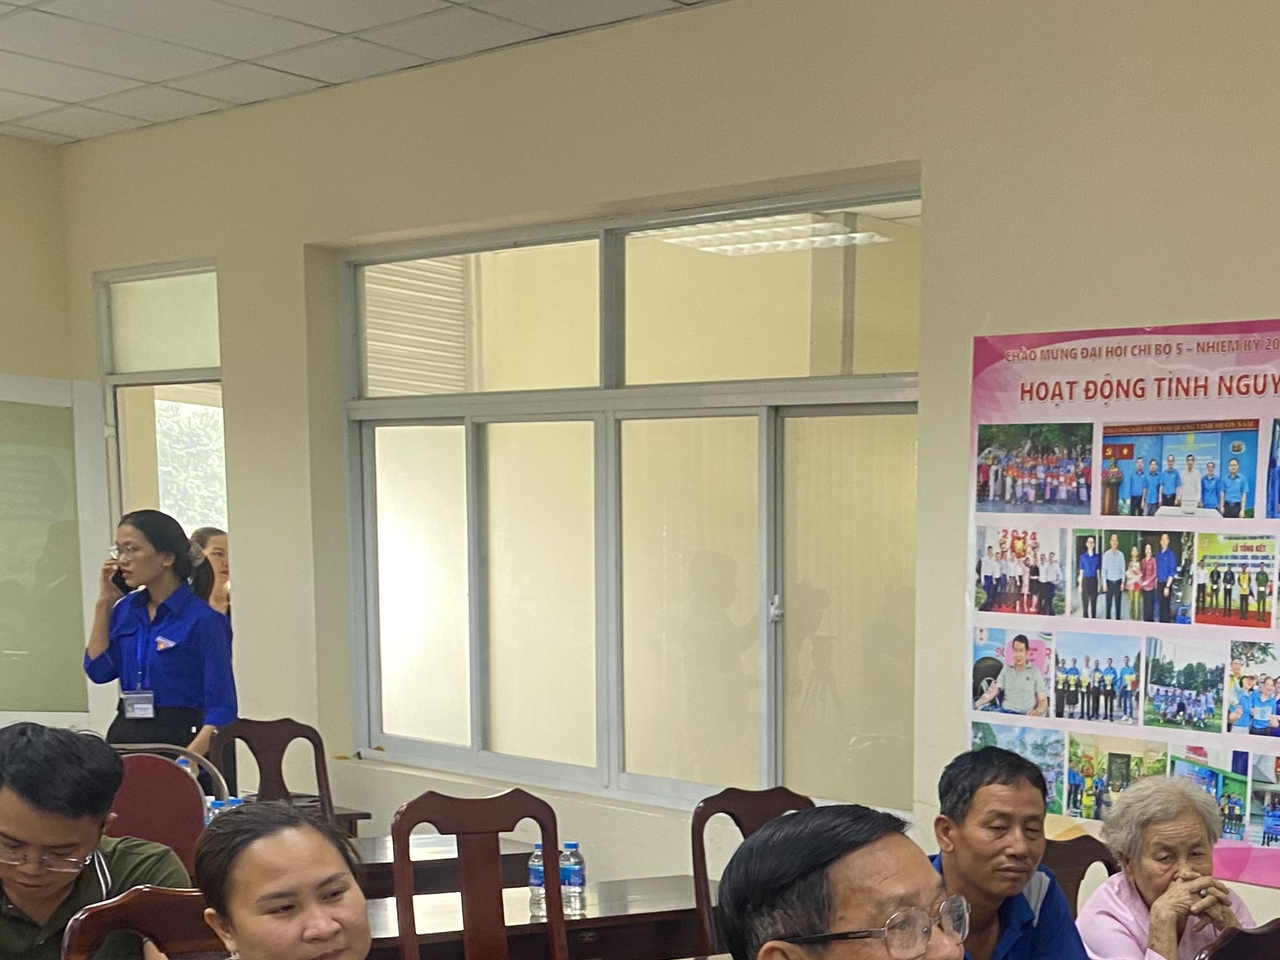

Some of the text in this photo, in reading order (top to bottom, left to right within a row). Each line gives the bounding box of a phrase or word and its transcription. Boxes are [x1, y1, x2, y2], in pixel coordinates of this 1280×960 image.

[1005, 345, 1037, 362] CHÀO
[1080, 346, 1102, 362] ĐẠI
[1105, 342, 1128, 361] HỘI
[1130, 343, 1151, 357] CHI
[1154, 340, 1173, 359] BỘ
[1175, 342, 1184, 355] 5
[1196, 338, 1240, 357] NHIỆM
[1020, 381, 1078, 407] HOẠT
[1083, 373, 1146, 407] ĐỘNG
[1153, 370, 1209, 398] TÌNH
